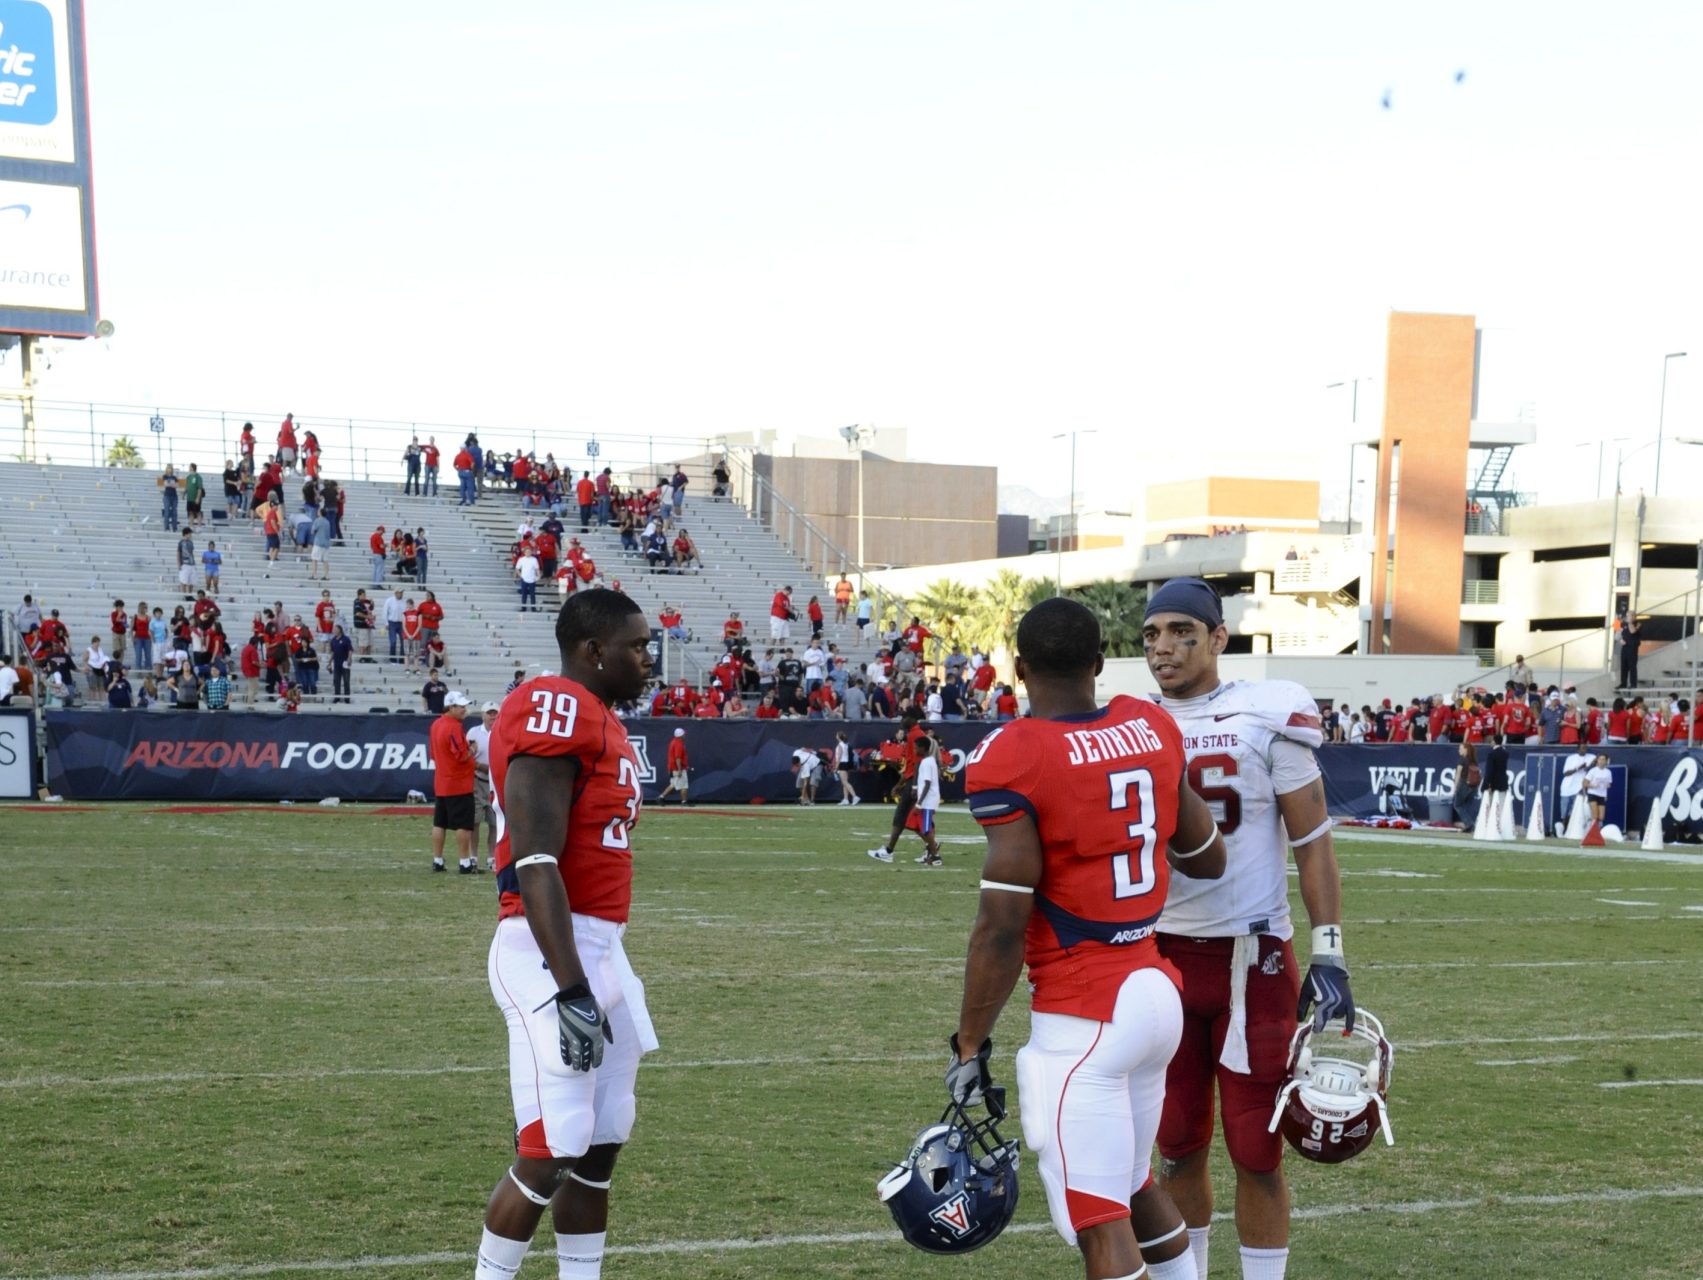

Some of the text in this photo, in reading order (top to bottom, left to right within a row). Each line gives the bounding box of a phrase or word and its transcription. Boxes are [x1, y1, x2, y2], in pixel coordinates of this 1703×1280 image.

[526, 690, 578, 738] 39
[280, 742, 436, 770] FOOTBA
[1063, 717, 1163, 765] JENKINS
[1202, 734, 1238, 748] STATE
[602, 757, 643, 849] 3
[1369, 766, 1457, 797] WELLS
[1107, 768, 1158, 900] 3
